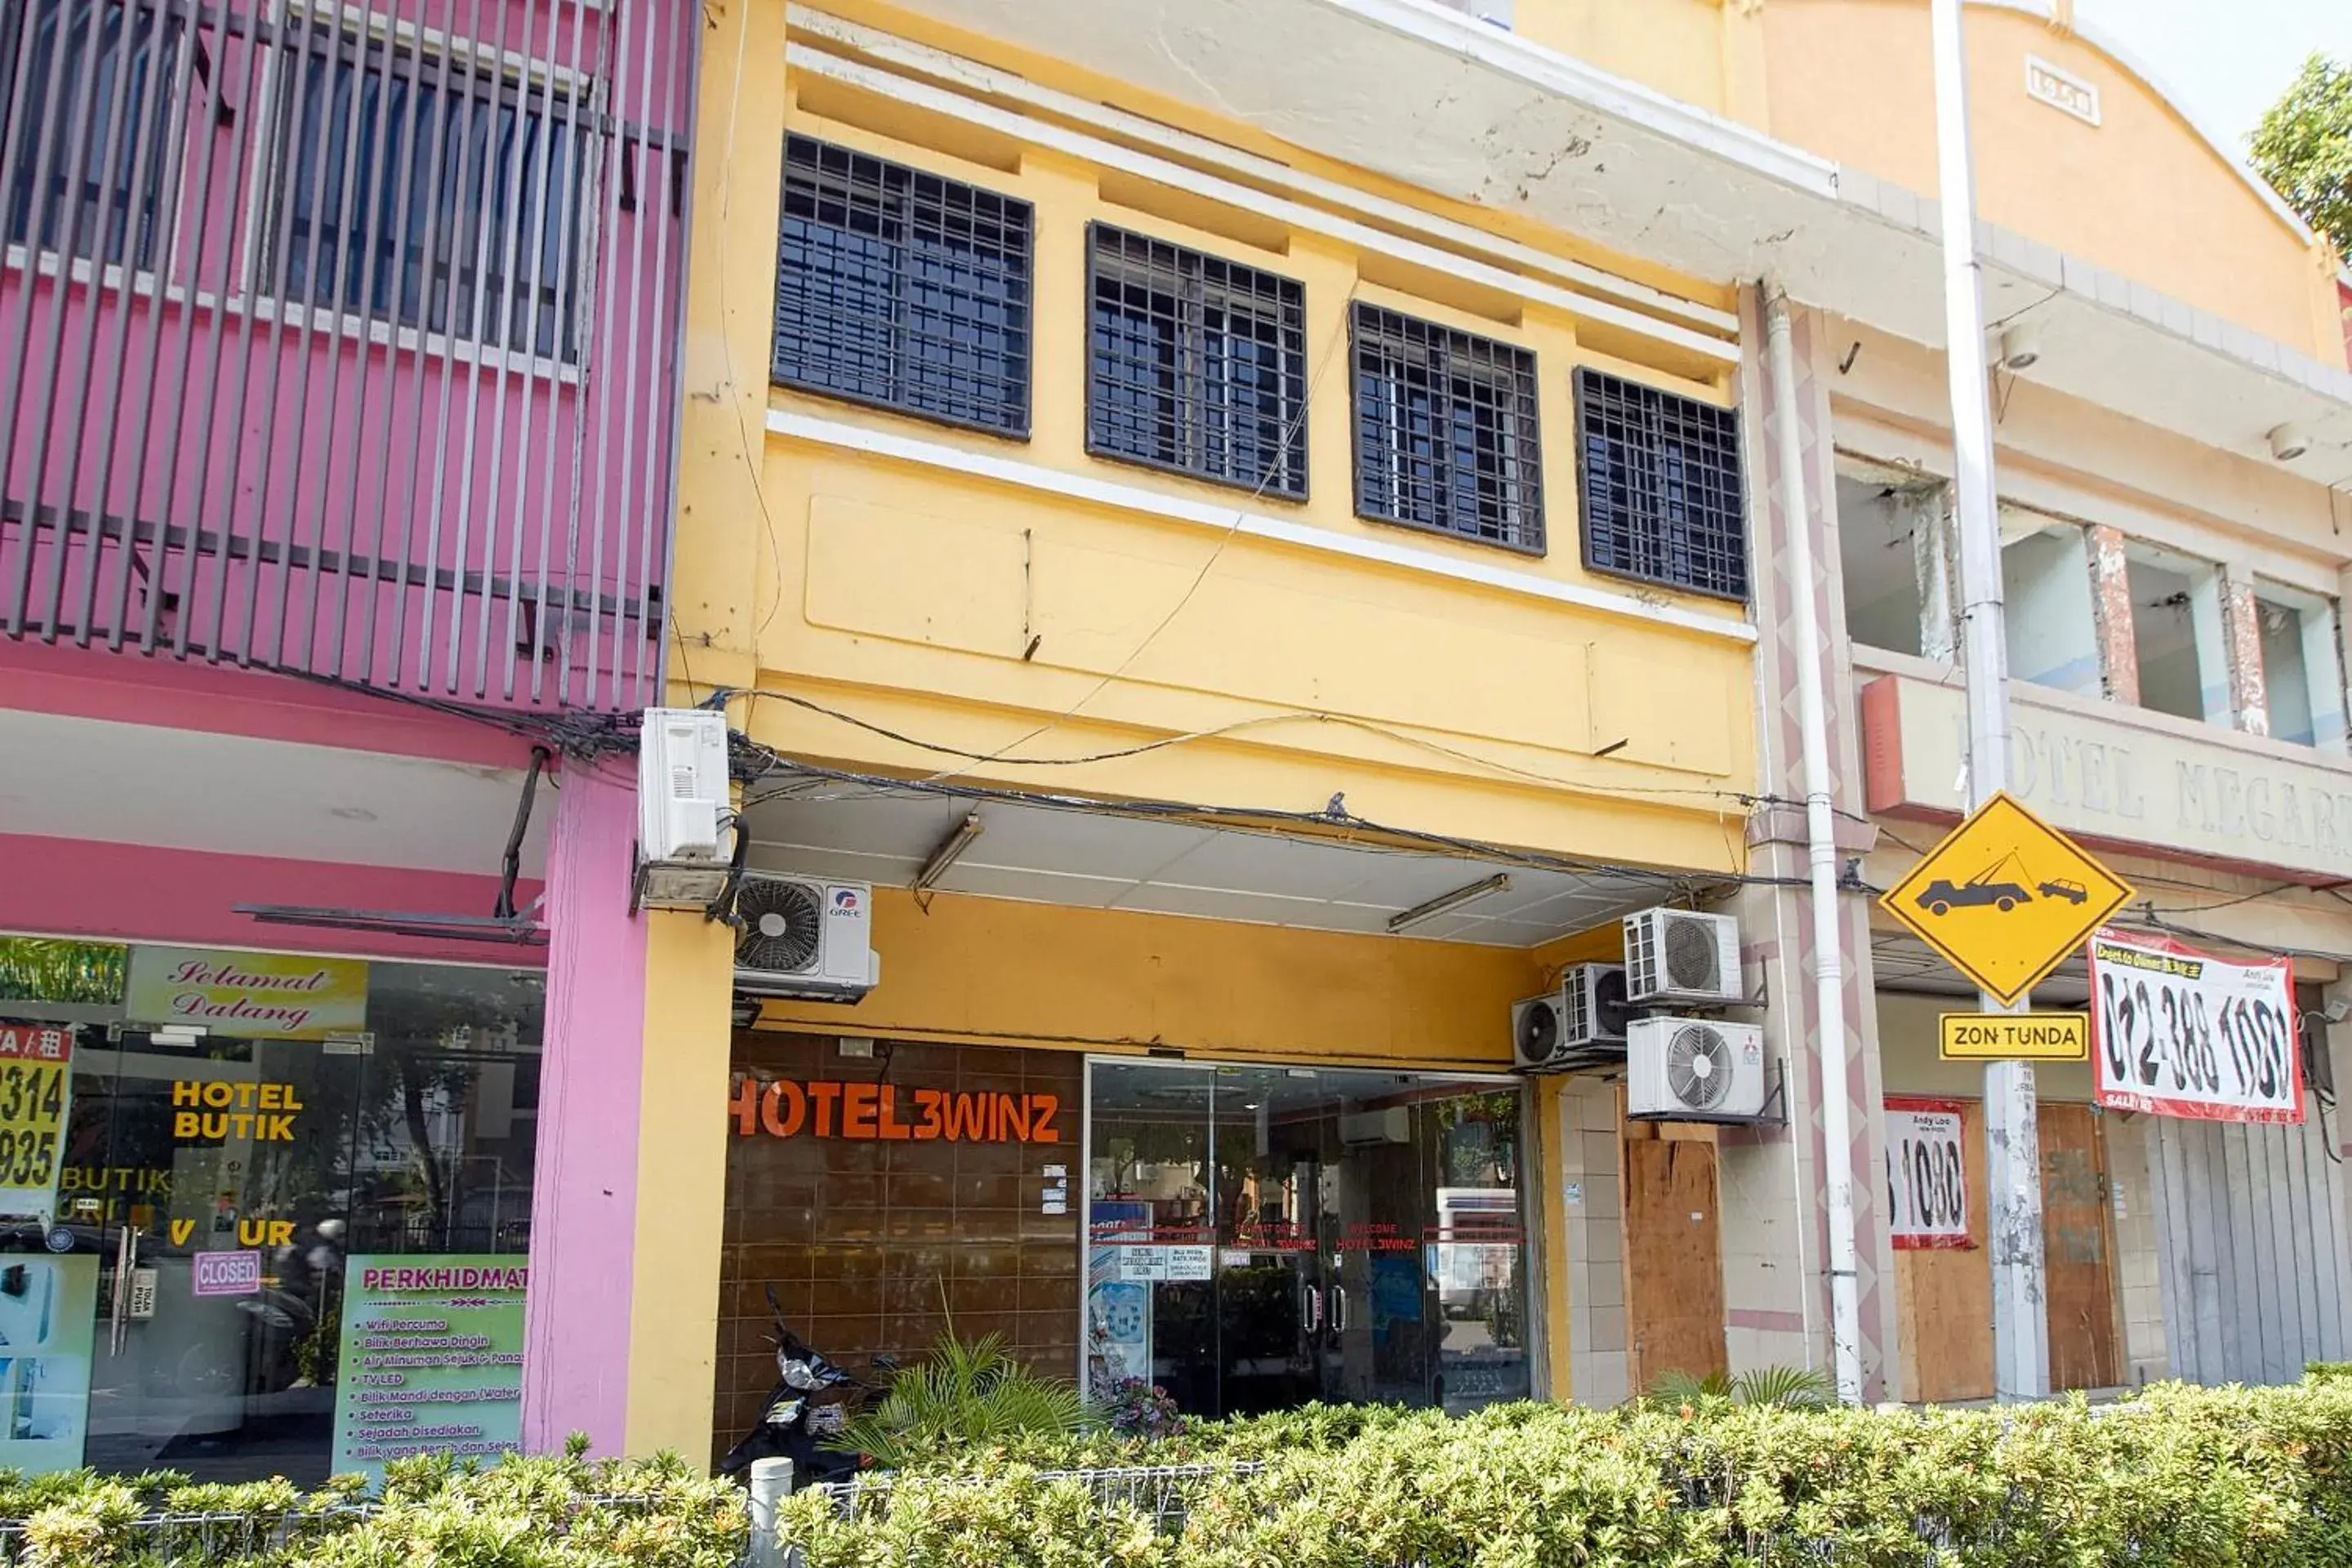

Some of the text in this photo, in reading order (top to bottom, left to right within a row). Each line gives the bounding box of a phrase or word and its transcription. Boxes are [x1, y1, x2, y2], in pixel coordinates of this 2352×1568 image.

[1953, 712, 2144, 819] OTEL
[167, 960, 325, 991] Selamat
[173, 992, 310, 1030] Datang
[1954, 1027, 2078, 1045] ZON TUNDA
[173, 1080, 303, 1110] HOTEL
[174, 1111, 296, 1141] BUTIK
[61, 1167, 173, 1192] BUTIK
[200, 1261, 256, 1285] CLOSED
[135, 1286, 144, 1313] PUSH
[394, 1337, 447, 1348] Berhawa
[451, 1336, 488, 1348] Dingin
[385, 1355, 439, 1365] Minuman
[443, 1353, 477, 1365] Sejuk
[363, 1374, 402, 1383] TV LED
[361, 1392, 386, 1402] Bilik
[390, 1391, 426, 1401] Mandi
[430, 1390, 475, 1402] dengan
[360, 1410, 412, 1420] Seterika
[359, 1425, 479, 1440] Sejadah Disediakan
[461, 1441, 484, 1452] dan
